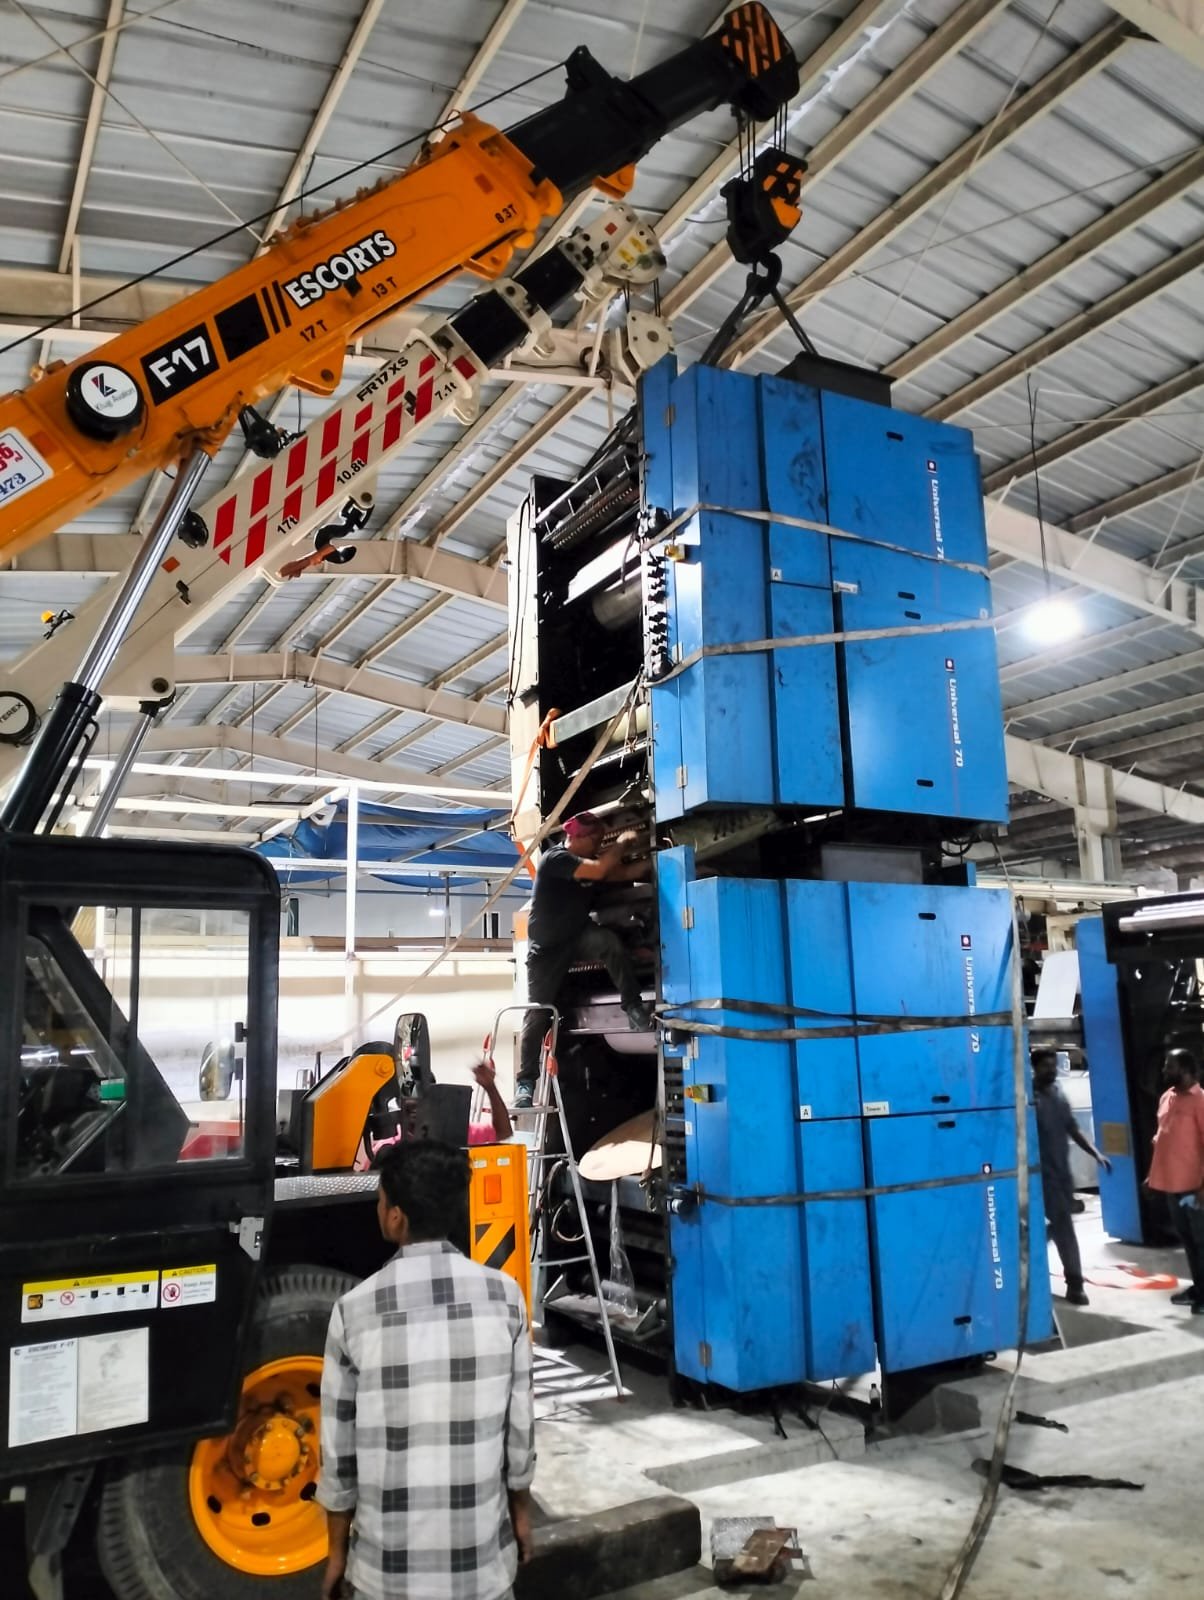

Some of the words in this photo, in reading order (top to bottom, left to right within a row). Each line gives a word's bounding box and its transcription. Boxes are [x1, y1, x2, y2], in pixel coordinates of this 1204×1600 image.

[283, 230, 397, 309] ESCORTS
[149, 336, 210, 389] F17
[434, 381, 457, 400] 7.1t
[336, 458, 366, 485] 10.8t
[277, 515, 299, 535] 17t
[931, 479, 943, 542] Universal
[949, 678, 962, 744] Universal
[955, 748, 964, 767] 70
[971, 1032, 980, 1053] 70
[986, 1186, 1001, 1263] Universal
[994, 1267, 1003, 1289] 70
